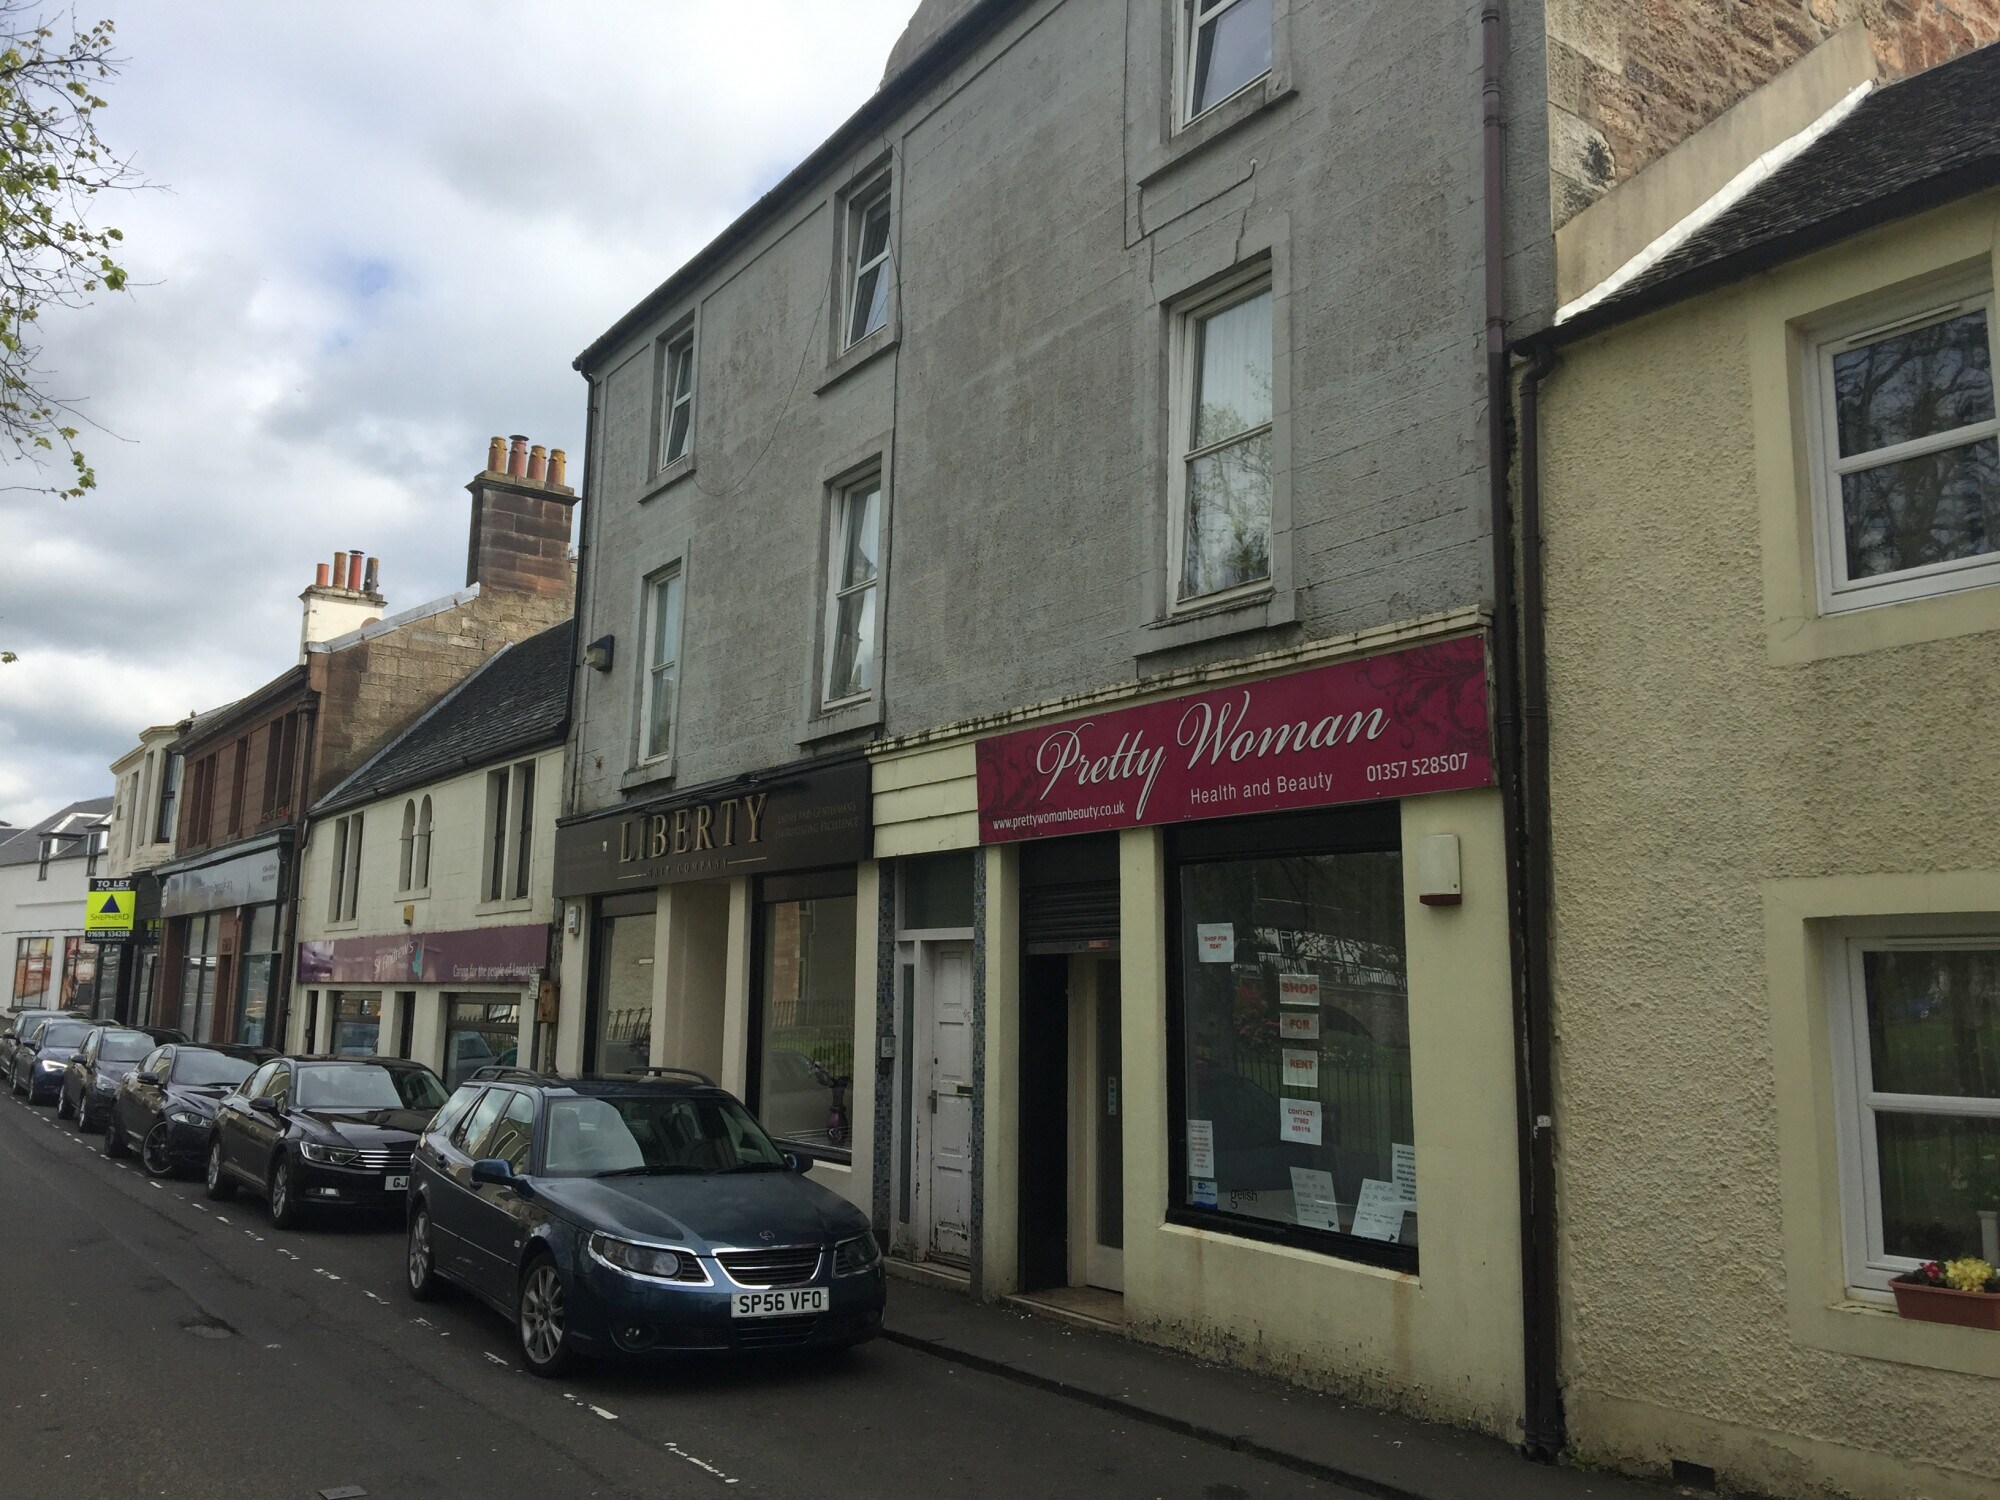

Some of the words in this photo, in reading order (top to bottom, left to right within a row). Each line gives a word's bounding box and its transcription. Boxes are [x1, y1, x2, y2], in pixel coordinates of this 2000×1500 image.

[1037, 722, 1167, 821] Pretty
[1177, 690, 1390, 770] Woman
[1366, 761, 1407, 782] 01357
[1411, 753, 1468, 777] 528507
[1191, 786, 1236, 805] Health
[1243, 778, 1270, 798] and
[1277, 773, 1333, 793] Beauty
[993, 801, 1125, 830] www.prettywomanbeauty.co.uk
[618, 793, 767, 863] LIBERTY
[677, 858, 728, 874] COMPANY
[97, 880, 110, 888] TO
[113, 880, 130, 888] LET
[90, 913, 129, 921] SHEPHERD
[453, 964, 469, 980] Caring
[478, 964, 487, 977] the
[487, 963, 504, 980] people
[505, 963, 512, 977] of
[1281, 982, 1318, 994] SHOP
[1289, 1019, 1310, 1030] FOR
[1289, 1058, 1314, 1069] RENT
[393, 1177, 408, 1188] GJ
[1230, 1189, 1258, 1209] gelish
[739, 1293, 785, 1314] SP56
[790, 1290, 822, 1310] VFO
